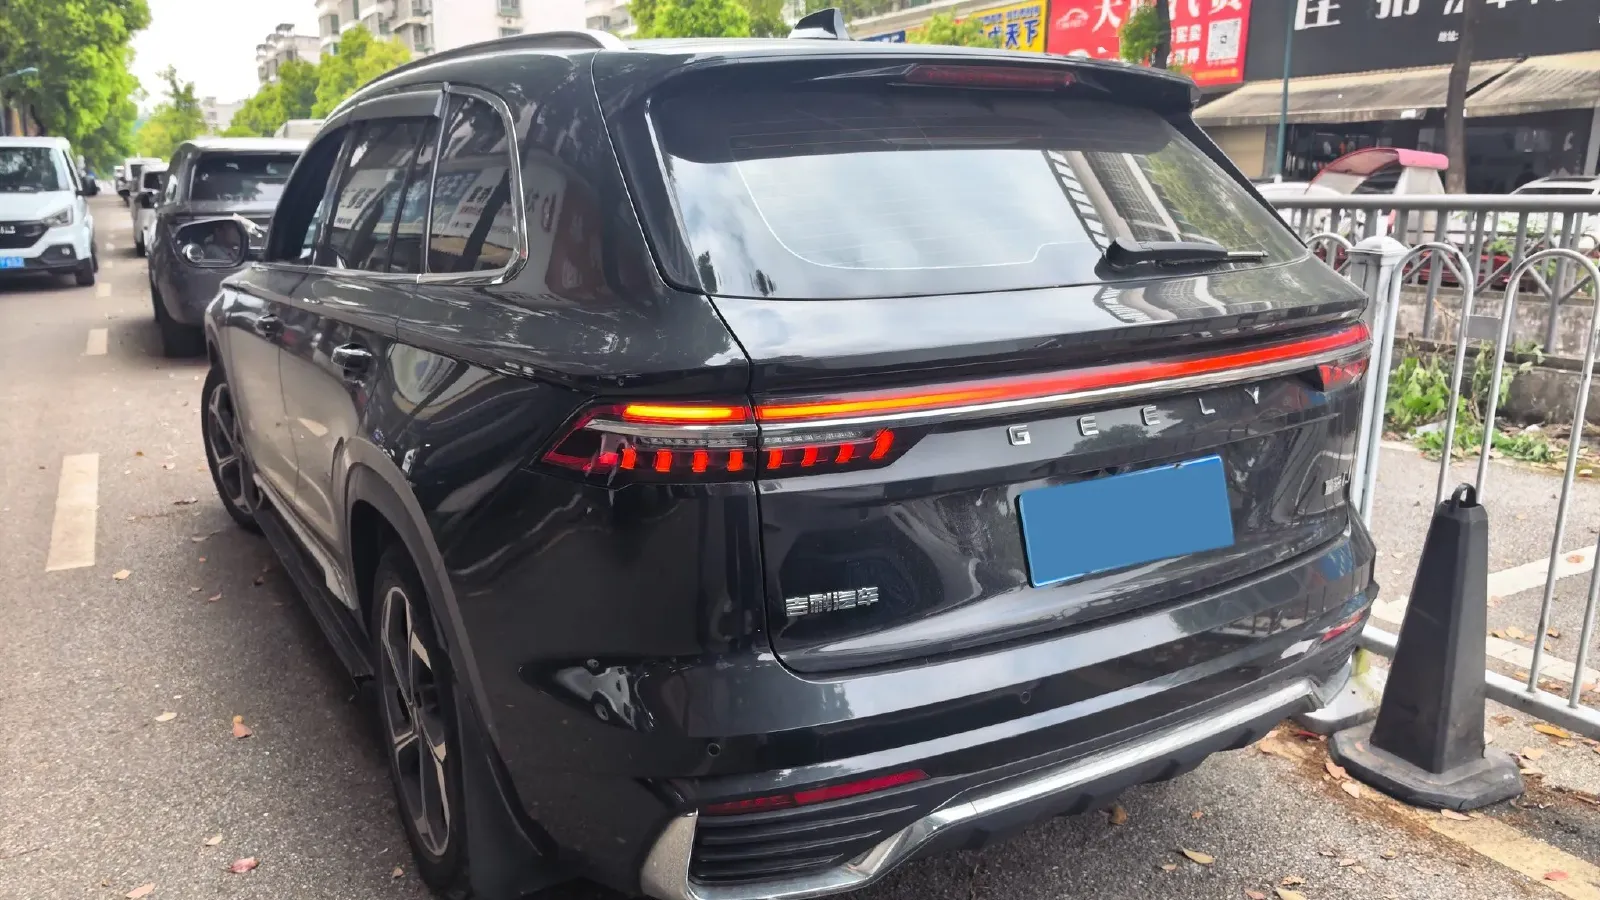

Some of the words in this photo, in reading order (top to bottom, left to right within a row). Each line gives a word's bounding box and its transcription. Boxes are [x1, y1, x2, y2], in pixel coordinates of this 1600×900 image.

[1007, 386, 1260, 446] GEELY
[785, 586, 879, 617] 吉利汽车
